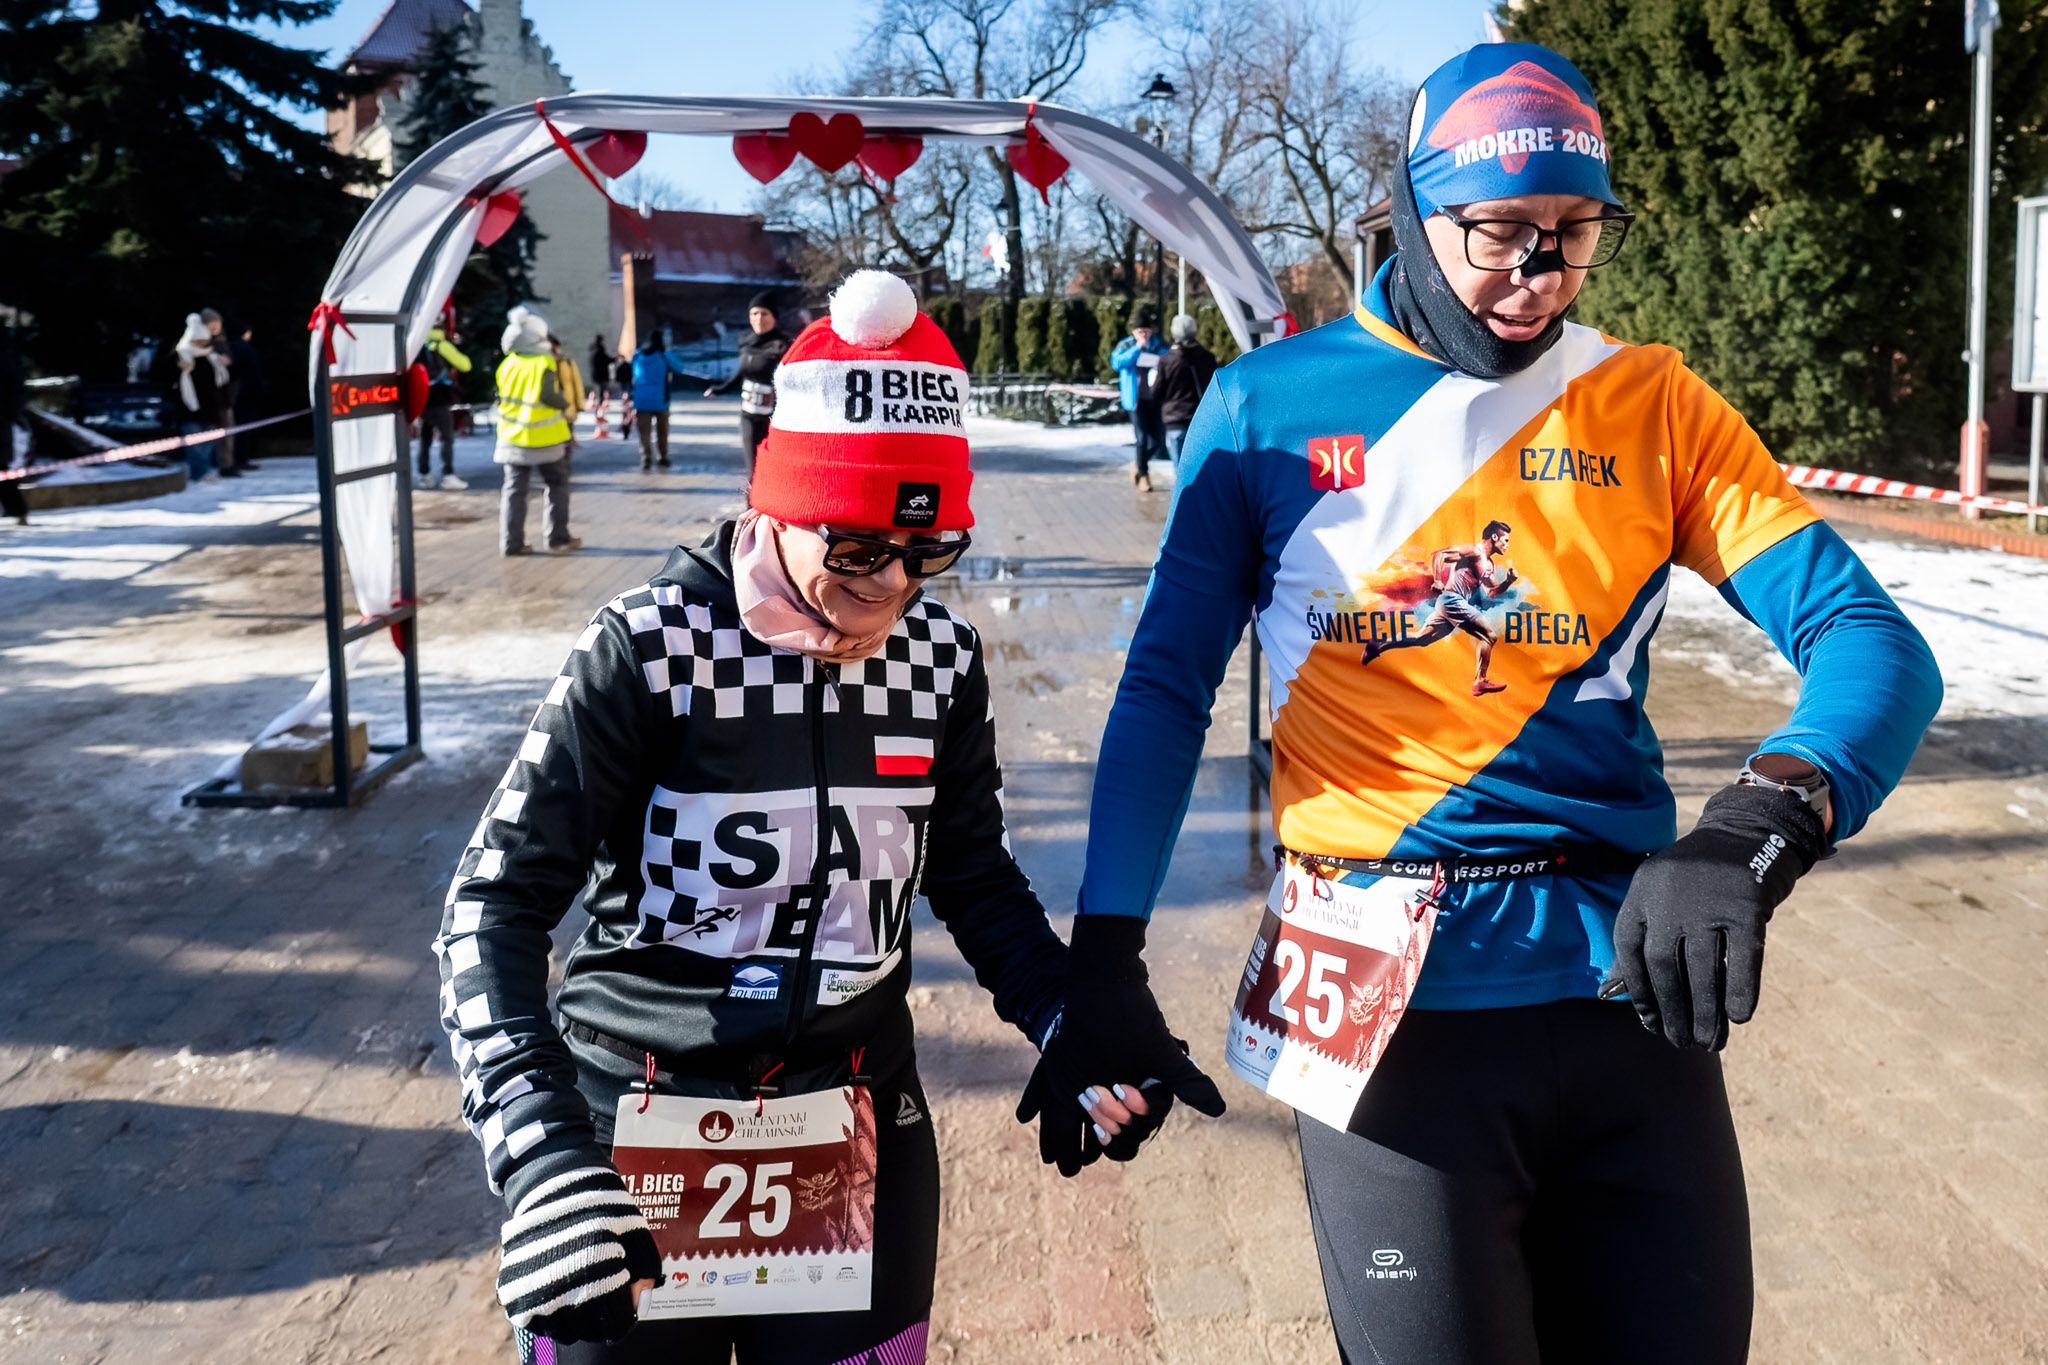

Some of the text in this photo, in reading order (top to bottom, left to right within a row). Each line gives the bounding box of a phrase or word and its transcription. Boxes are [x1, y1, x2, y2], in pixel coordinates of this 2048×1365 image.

[1455, 127, 1554, 169] MOKRE
[844, 368, 960, 424] 8 BIEG
[1519, 447, 1622, 487] CZAREK
[1306, 606, 1591, 647] ŚWIECIE BIEGA
[708, 804, 932, 889] START
[1749, 841, 1780, 876] HI-TEC
[1392, 860, 1548, 880] COMESSPORT
[717, 877, 917, 956] TEAM
[1268, 938, 1348, 1039] 25
[633, 1194, 681, 1206] OCHANYCH
[698, 1161, 794, 1239] 25
[1366, 1267, 1418, 1281] Kalenji
